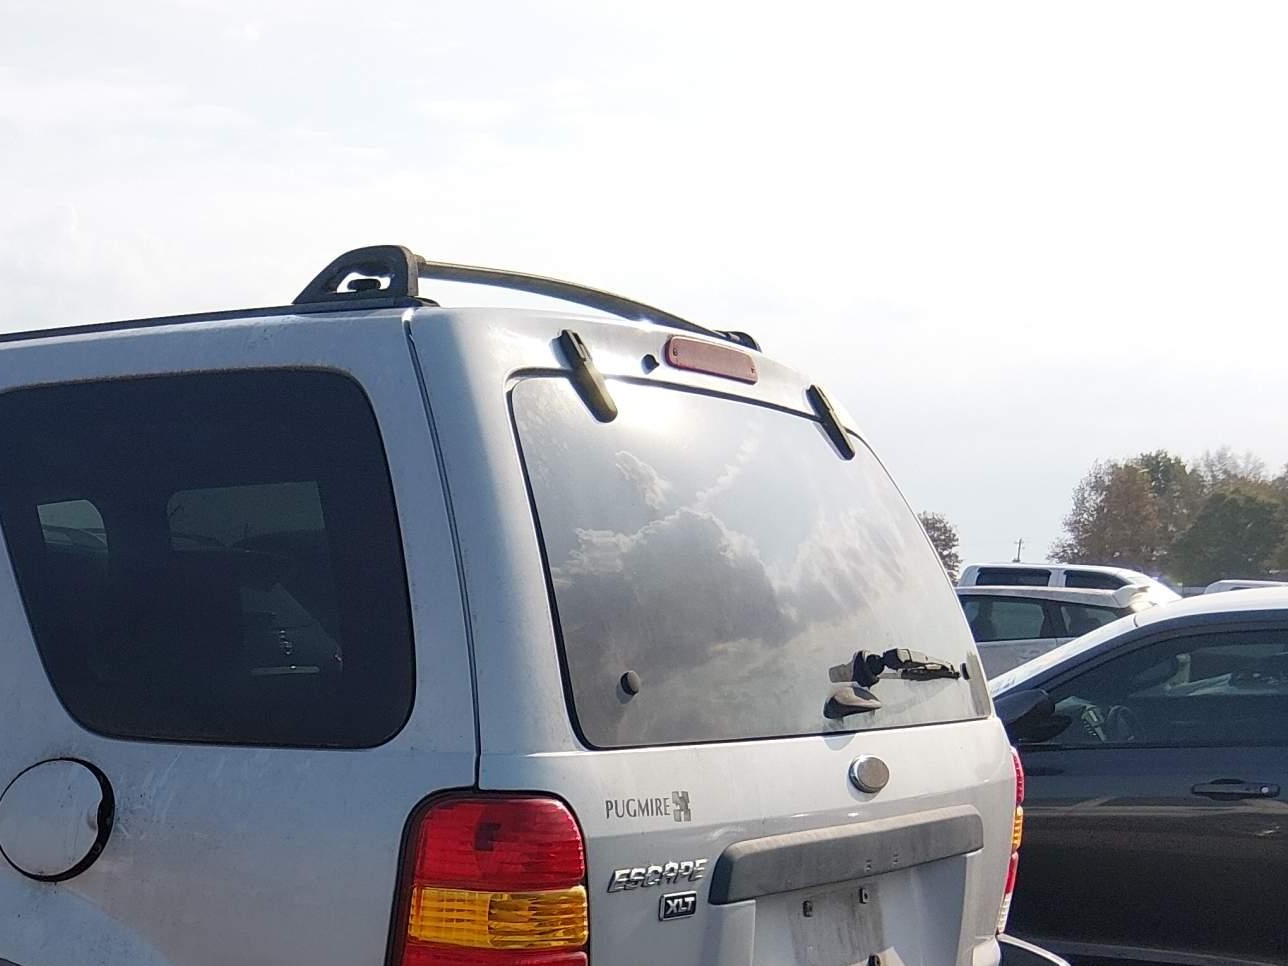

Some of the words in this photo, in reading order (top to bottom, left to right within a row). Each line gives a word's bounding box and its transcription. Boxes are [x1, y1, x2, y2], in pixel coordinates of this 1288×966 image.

[605, 797, 671, 819] PUGMIRE
[607, 858, 709, 893] ESCAPE
[665, 896, 696, 915] XLT
